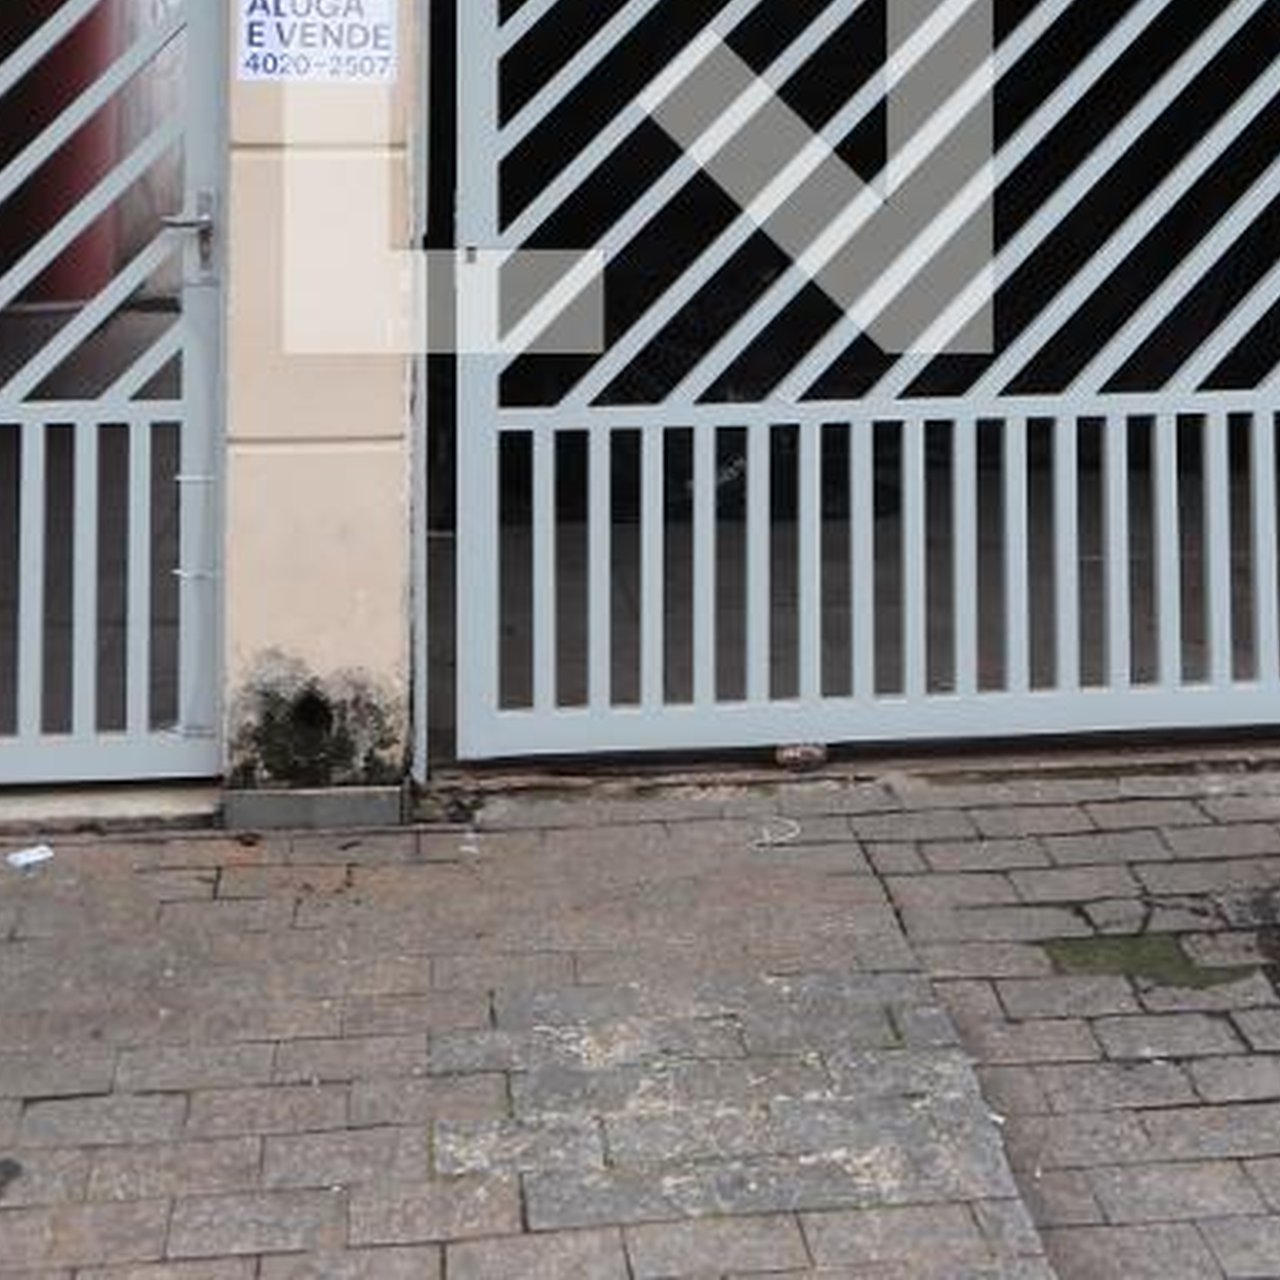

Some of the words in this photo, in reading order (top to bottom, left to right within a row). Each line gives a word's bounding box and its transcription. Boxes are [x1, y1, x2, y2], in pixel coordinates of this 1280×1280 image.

[247, 21, 266, 48] E
[275, 22, 392, 51] VENDE
[244, 52, 392, 78] 4020-2507
